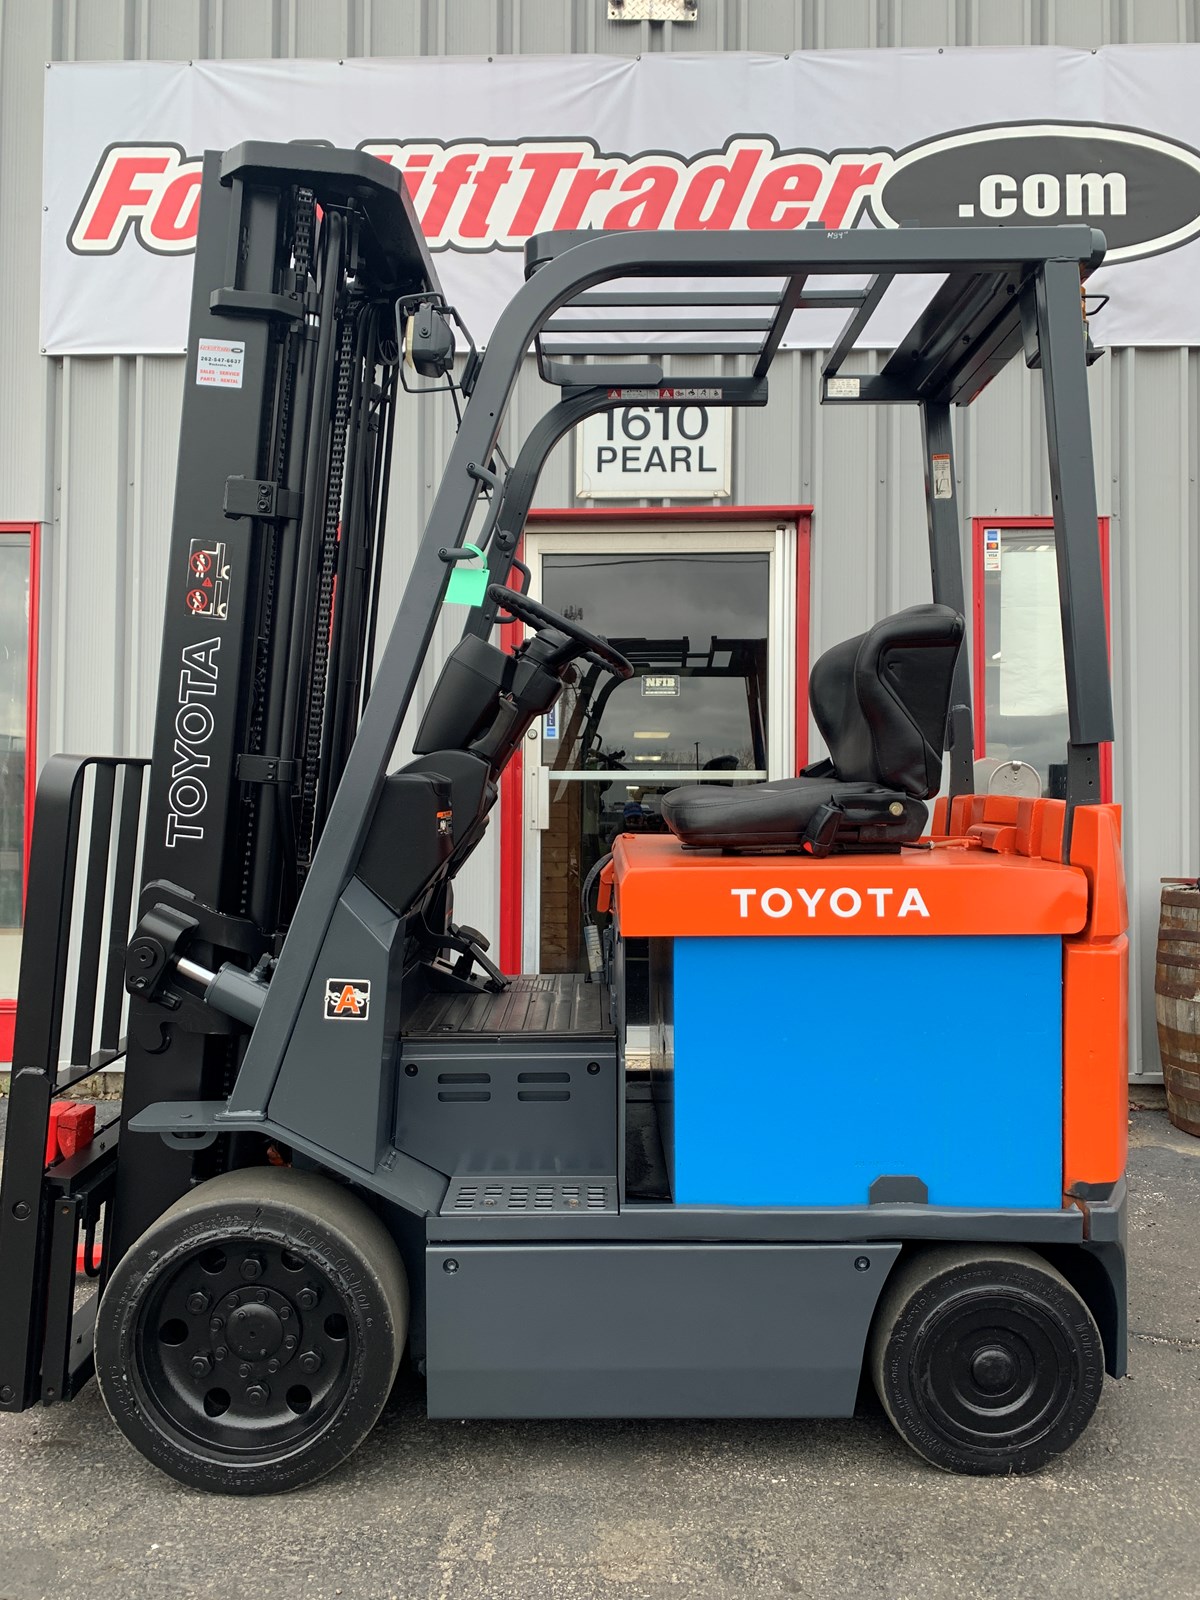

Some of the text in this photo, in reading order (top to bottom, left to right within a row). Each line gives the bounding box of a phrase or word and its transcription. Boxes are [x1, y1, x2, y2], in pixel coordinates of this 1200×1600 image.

[82, 149, 883, 240] FoiftTrader
[600, 406, 709, 441] 1610
[597, 446, 717, 473] PEARL
[645, 677, 676, 687] NFIB
[165, 636, 222, 848] TOYOTA
[730, 886, 931, 918] TOYOTA
